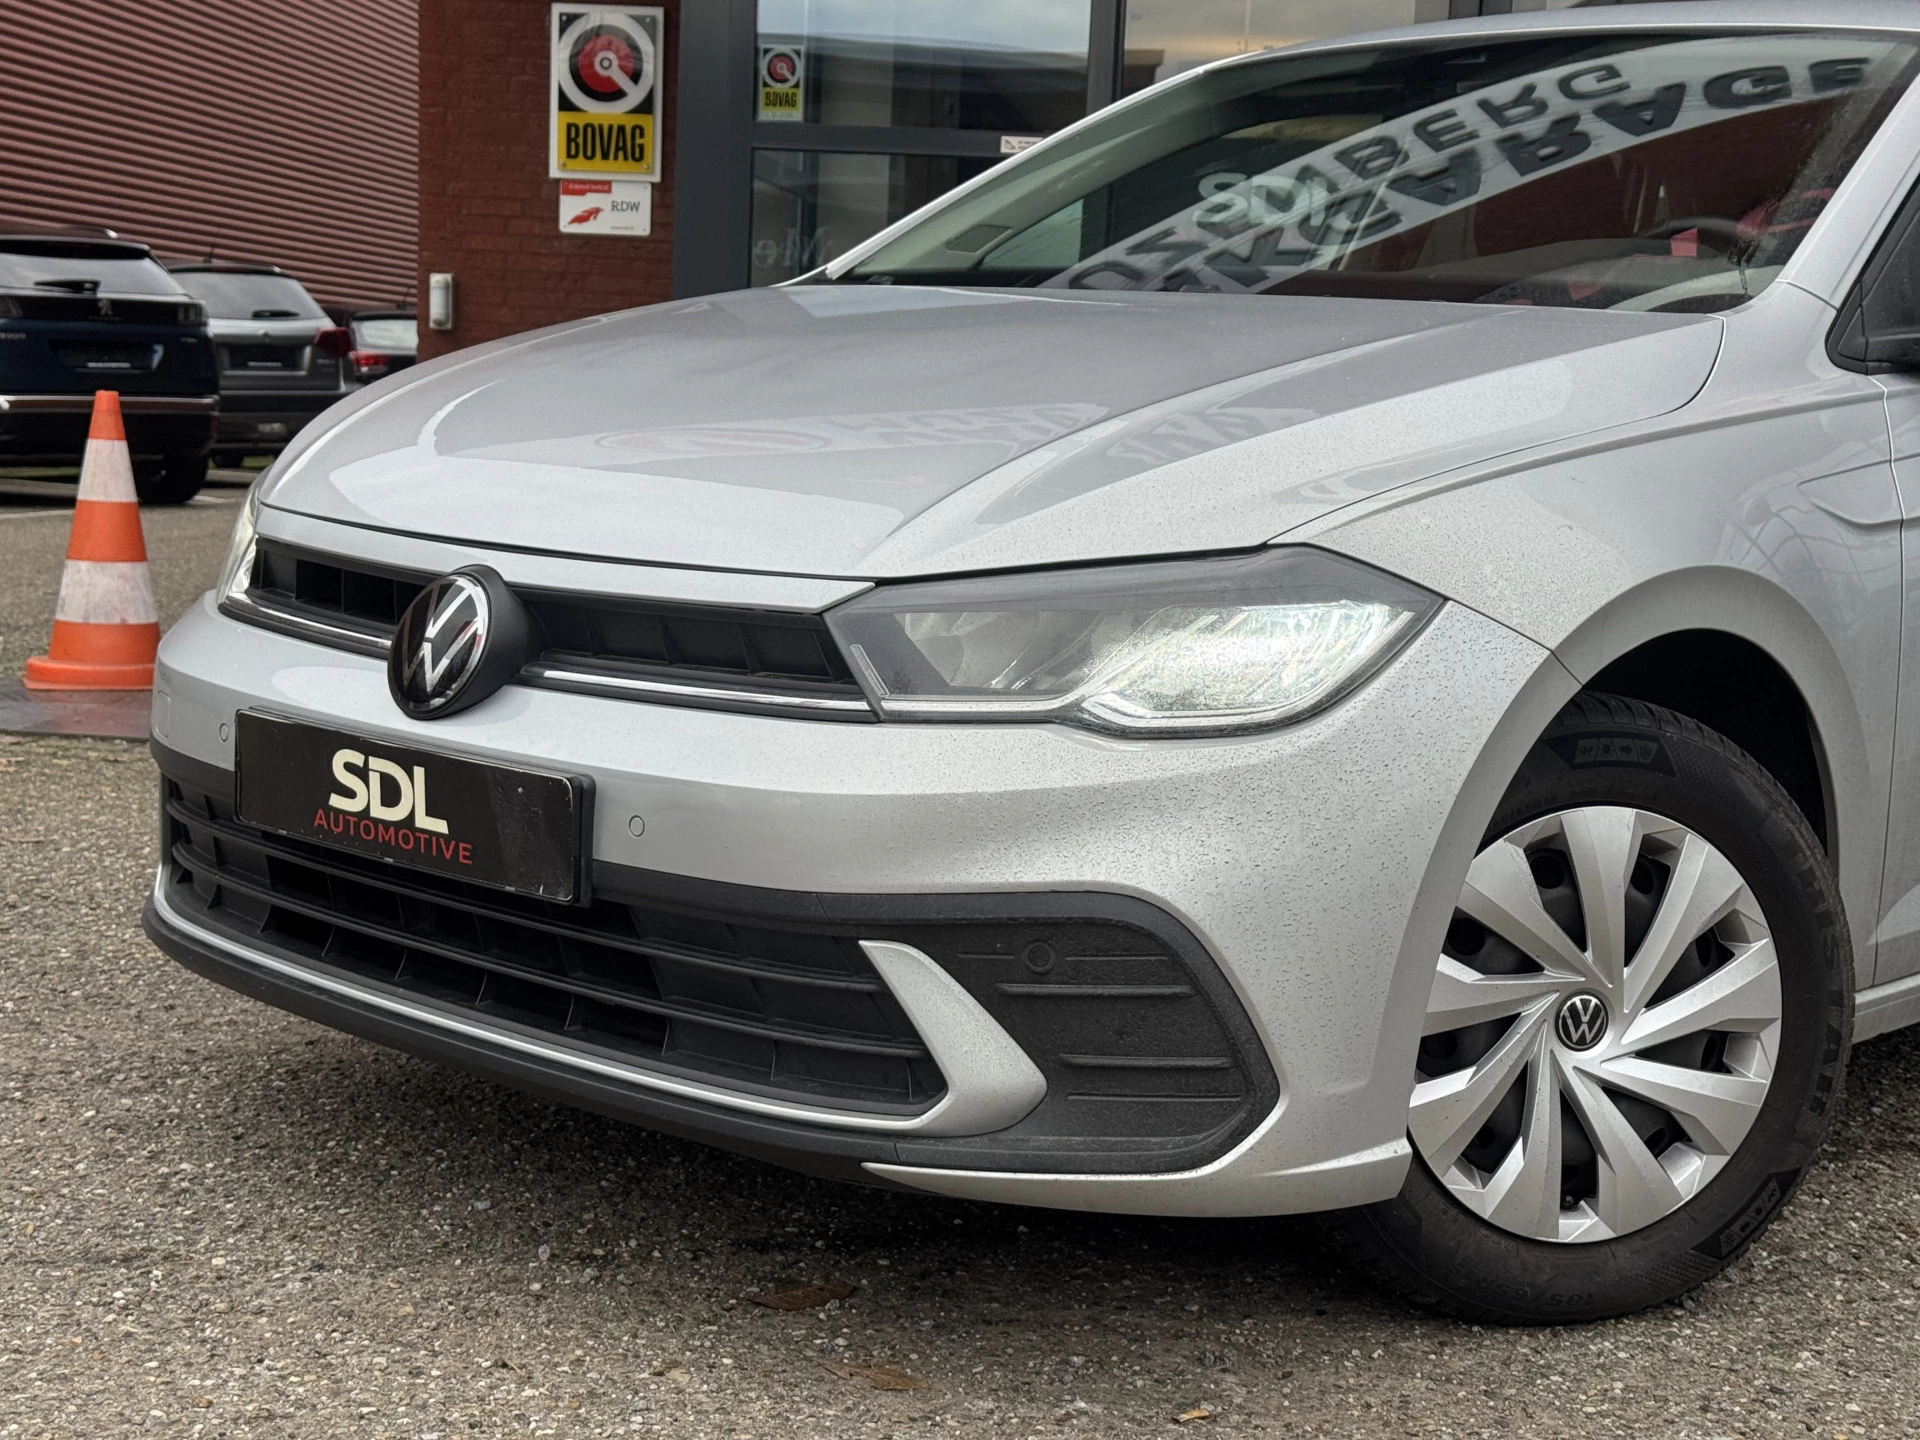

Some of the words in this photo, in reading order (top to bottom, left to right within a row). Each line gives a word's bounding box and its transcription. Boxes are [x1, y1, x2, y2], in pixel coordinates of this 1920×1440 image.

[764, 90, 798, 108] BOVAG
[565, 122, 646, 163] BOVAG
[610, 200, 641, 213] RDW
[328, 748, 449, 835] SDL
[313, 808, 473, 865] AUTOMOTIVE
[1560, 995, 1606, 1048] VW
